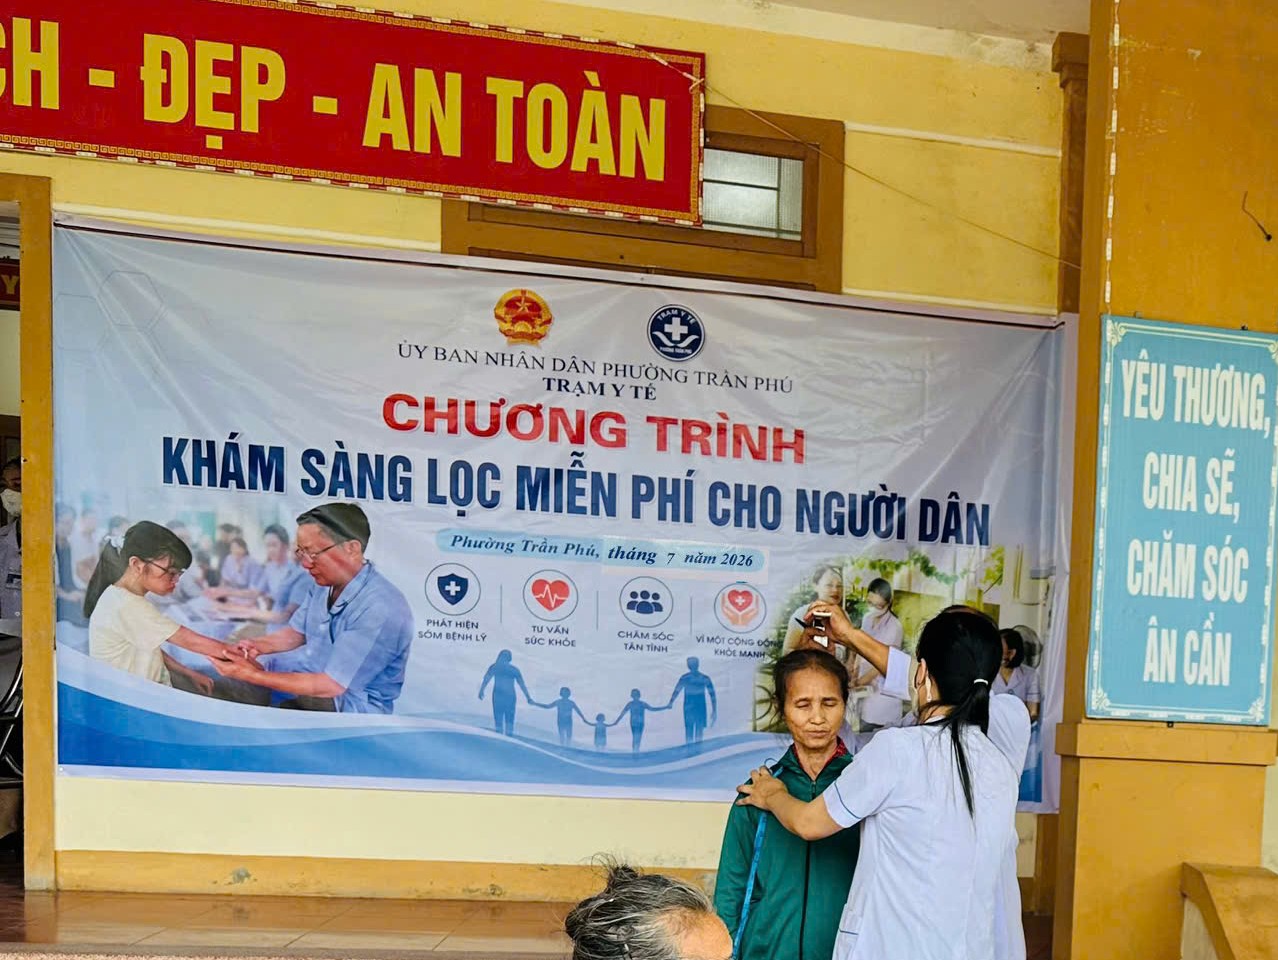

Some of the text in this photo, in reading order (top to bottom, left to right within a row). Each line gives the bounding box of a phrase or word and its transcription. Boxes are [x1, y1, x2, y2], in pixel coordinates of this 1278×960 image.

[0, 17, 666, 182] H - ĐẸP - AN TOÀN
[398, 339, 428, 359] ỦY
[434, 346, 478, 364] BAN
[485, 350, 546, 370] NHÂN
[552, 355, 596, 375] DÂN
[602, 361, 689, 384] PHƯỜNG
[754, 375, 793, 394] PHÚ
[542, 376, 657, 401] TRẠM Y TẾ
[1121, 348, 1271, 439] YÊU THƯƠNG,
[382, 393, 805, 464] CHƯƠNG TRÌNH
[162, 432, 991, 547] KHÁM SÀNG LỌC MIỄN PHÍ CHO NGƯỜI DÂN
[1142, 451, 1198, 513] CHIA
[451, 534, 754, 567] Phường Trần Phú, tháng 7 năm 2026
[1126, 528, 1250, 604] CHĂM SÓC
[426, 617, 453, 629] PHÁT
[1142, 615, 1178, 685] ÂN
